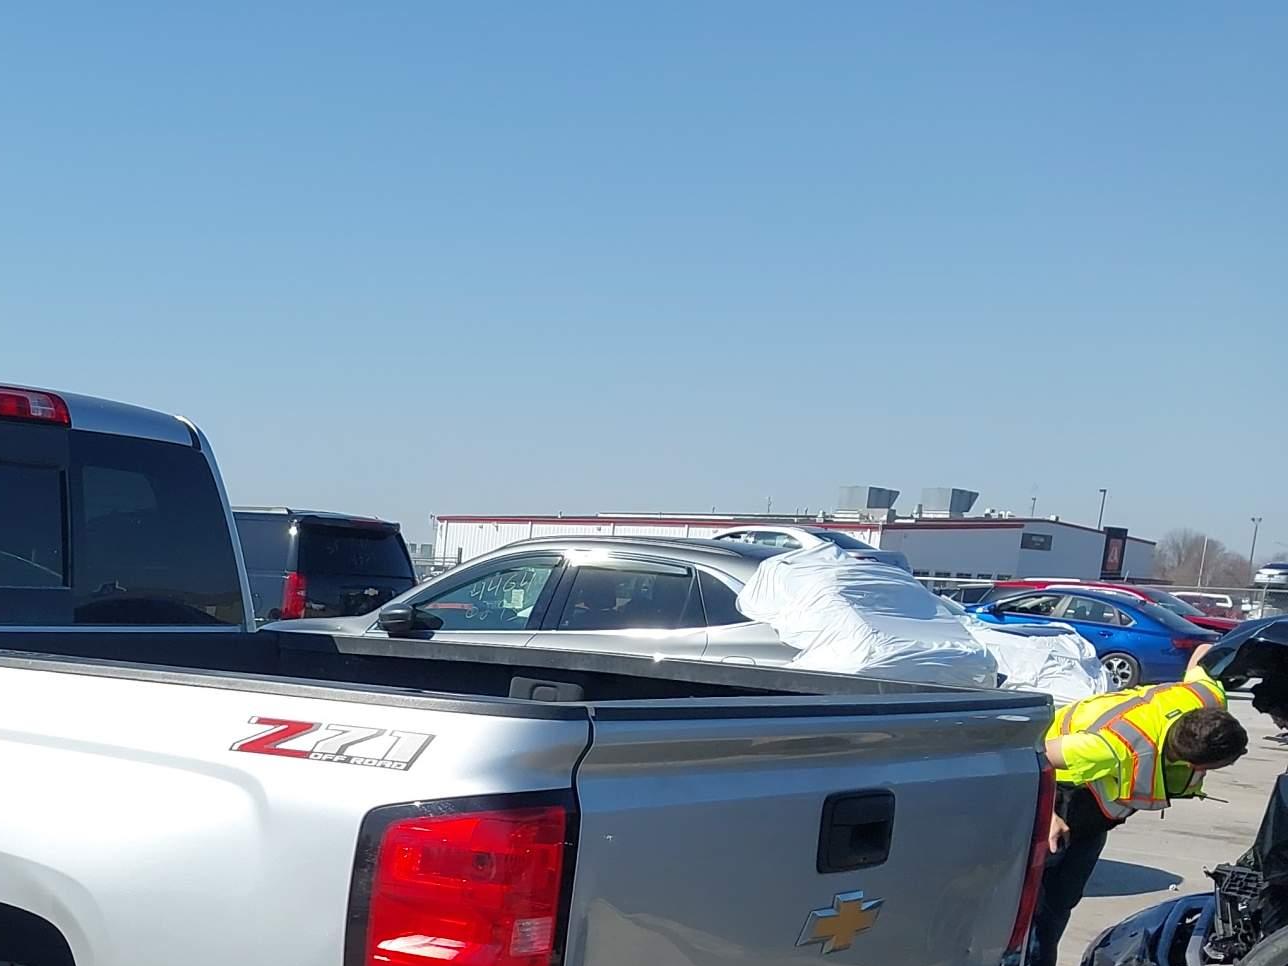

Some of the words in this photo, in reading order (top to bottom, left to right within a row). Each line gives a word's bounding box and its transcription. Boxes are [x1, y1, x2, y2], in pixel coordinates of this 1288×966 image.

[229, 716, 436, 771] Z71
[309, 753, 347, 763] OFF
[350, 758, 408, 771] ROAD
